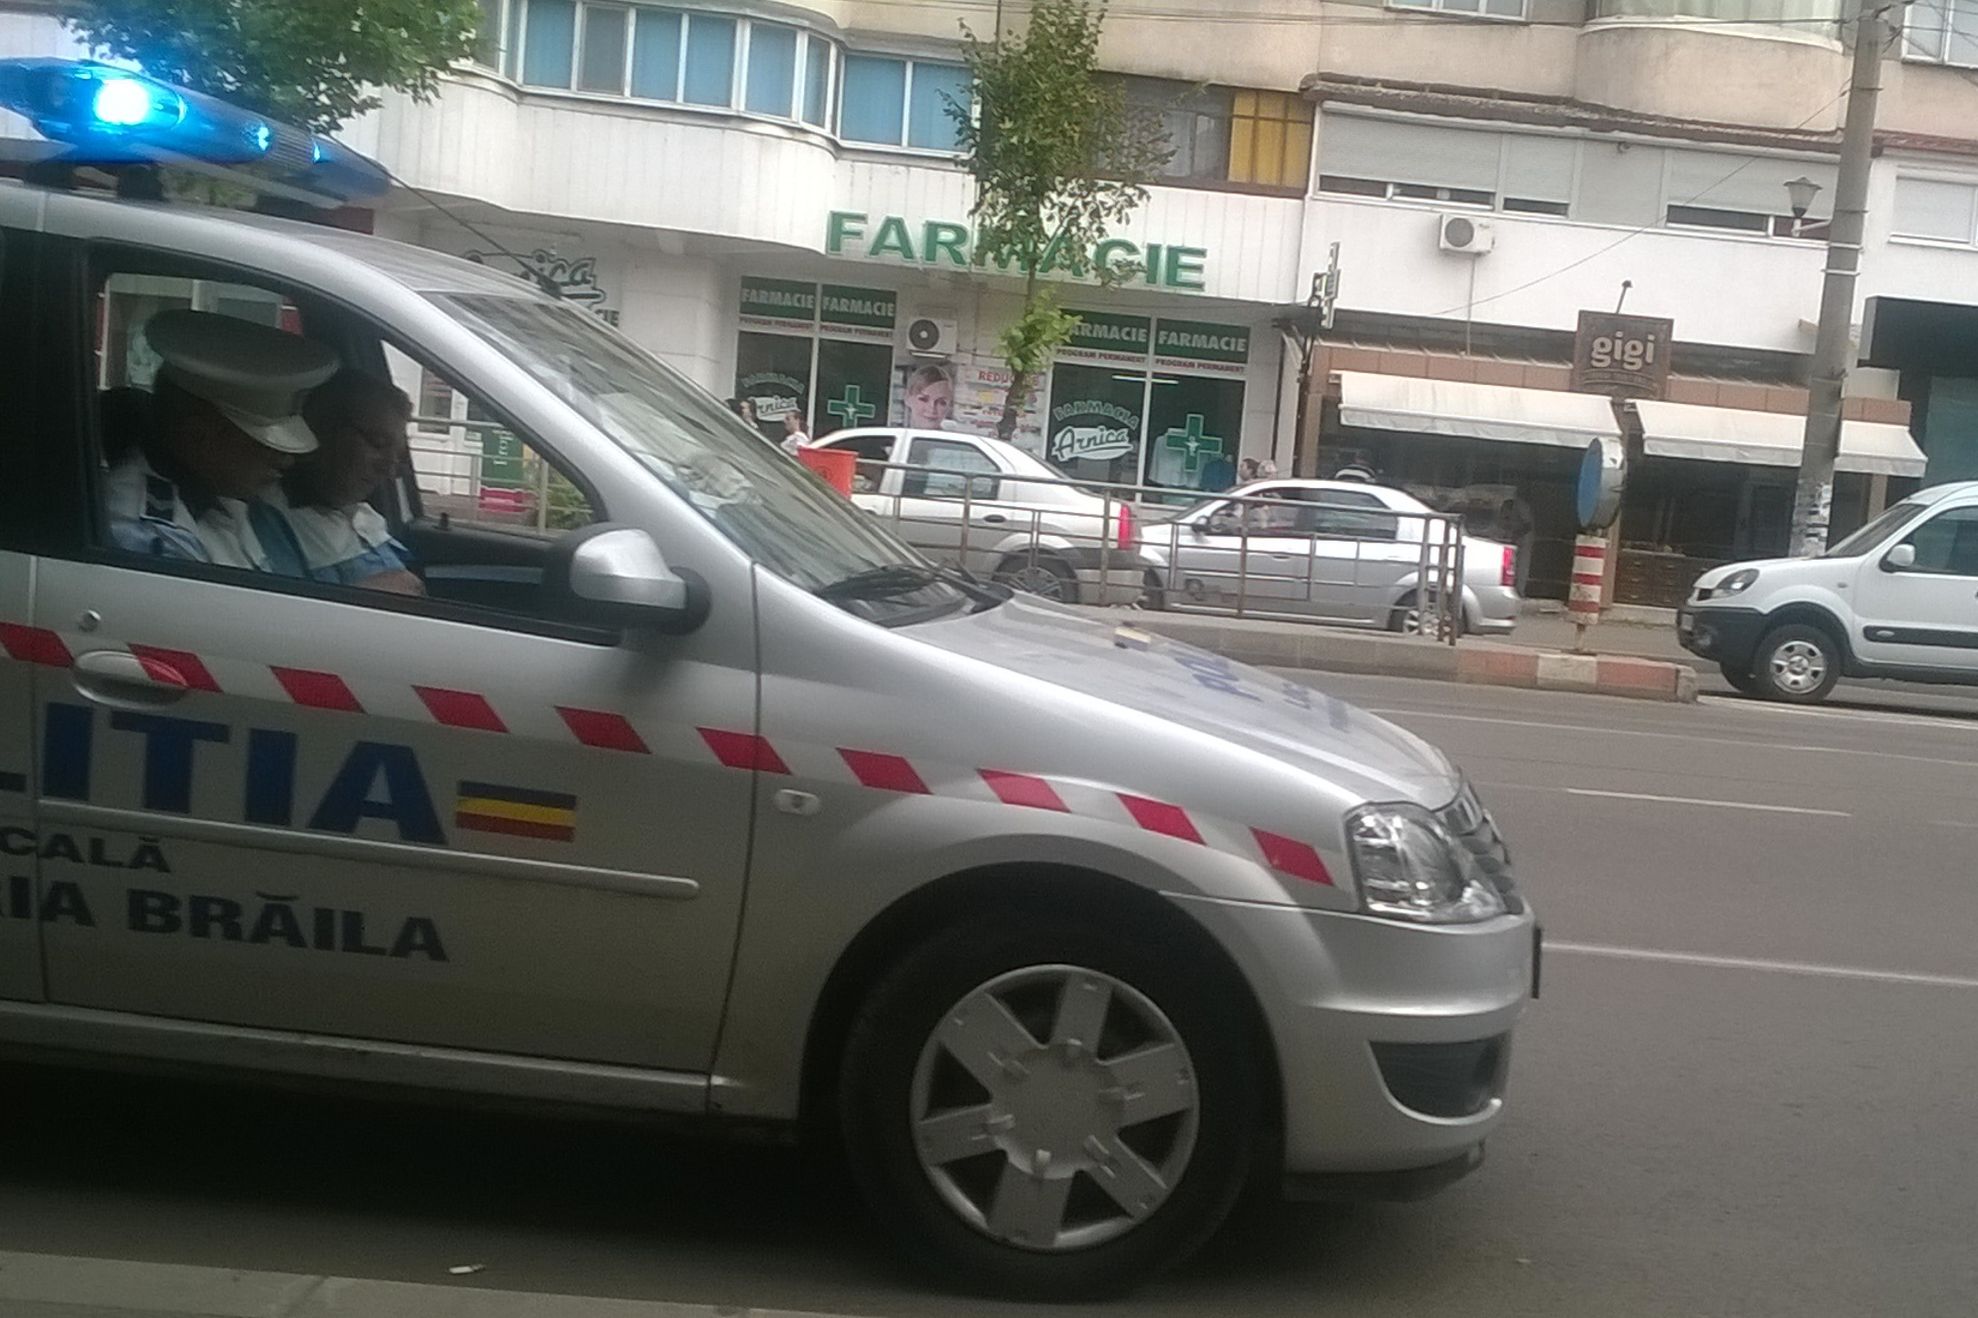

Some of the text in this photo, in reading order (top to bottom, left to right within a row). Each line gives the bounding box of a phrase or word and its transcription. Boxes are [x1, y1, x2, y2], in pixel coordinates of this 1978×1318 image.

[741, 288, 815, 309] FARMACIE
[821, 295, 896, 317] FARMACIE
[1068, 322, 1148, 343] ARMACIE
[1158, 330, 1247, 352] FARMACIE
[1590, 330, 1656, 371] gigi
[1052, 400, 1139, 431] FARMACIA
[1053, 426, 1131, 460] Arnica
[0, 702, 447, 844] ITIA
[0, 876, 450, 963] IA BRĂILA
